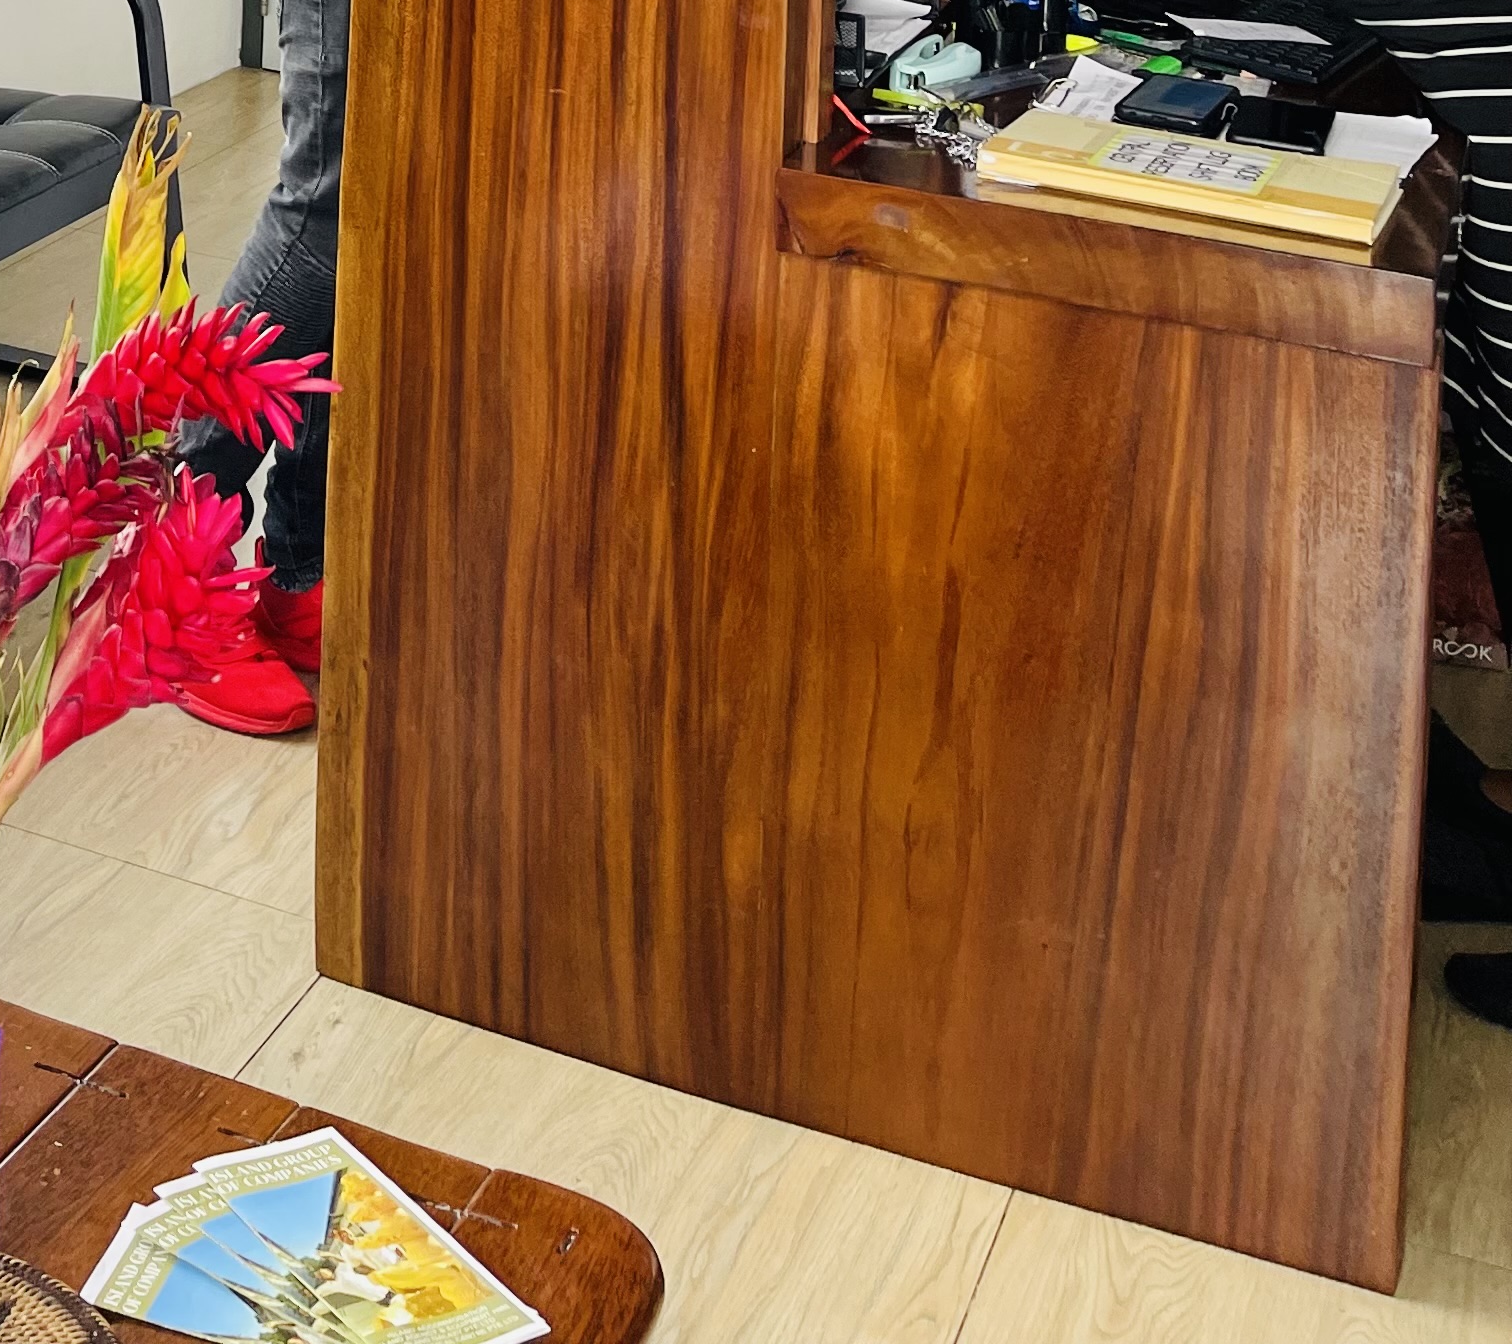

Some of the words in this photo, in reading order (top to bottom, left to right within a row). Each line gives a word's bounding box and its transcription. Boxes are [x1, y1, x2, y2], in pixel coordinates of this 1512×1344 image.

[208, 1159, 273, 1184] ISLAND
[273, 1144, 333, 1171] GROUP
[216, 1178, 240, 1195] OF
[243, 1155, 343, 1188] COMPANIES
[173, 1188, 219, 1209] ISLAN
[144, 1212, 187, 1238] ISLAN
[103, 1265, 140, 1307] ISLAND
[129, 1238, 154, 1264] GRO
[122, 1294, 142, 1314] OF
